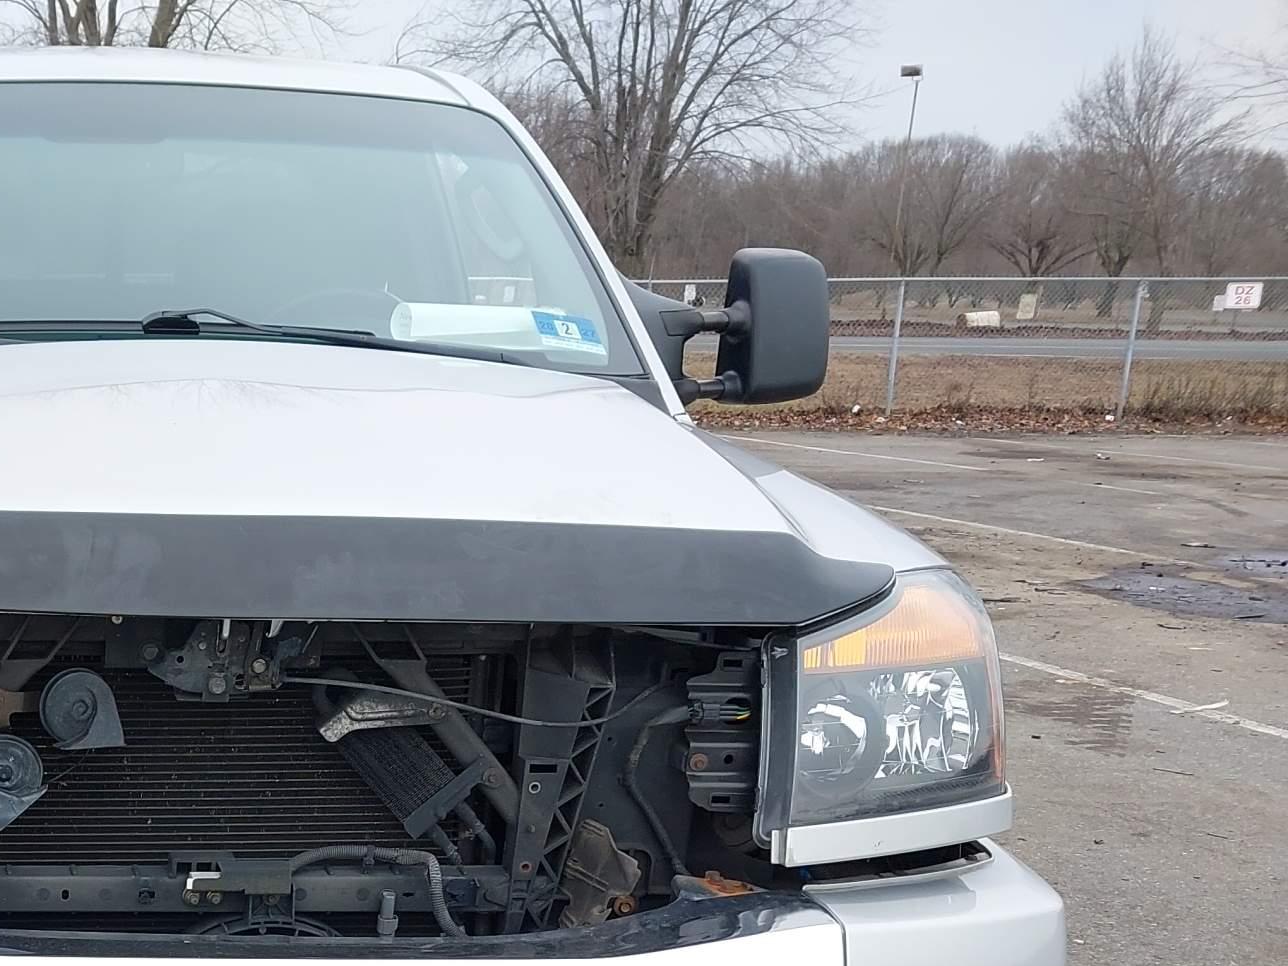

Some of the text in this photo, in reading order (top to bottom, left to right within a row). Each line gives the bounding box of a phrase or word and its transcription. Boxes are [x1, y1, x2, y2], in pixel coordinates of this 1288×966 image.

[1234, 286, 1255, 295] DZ
[1234, 296, 1251, 305] 26
[561, 322, 573, 336] 2
